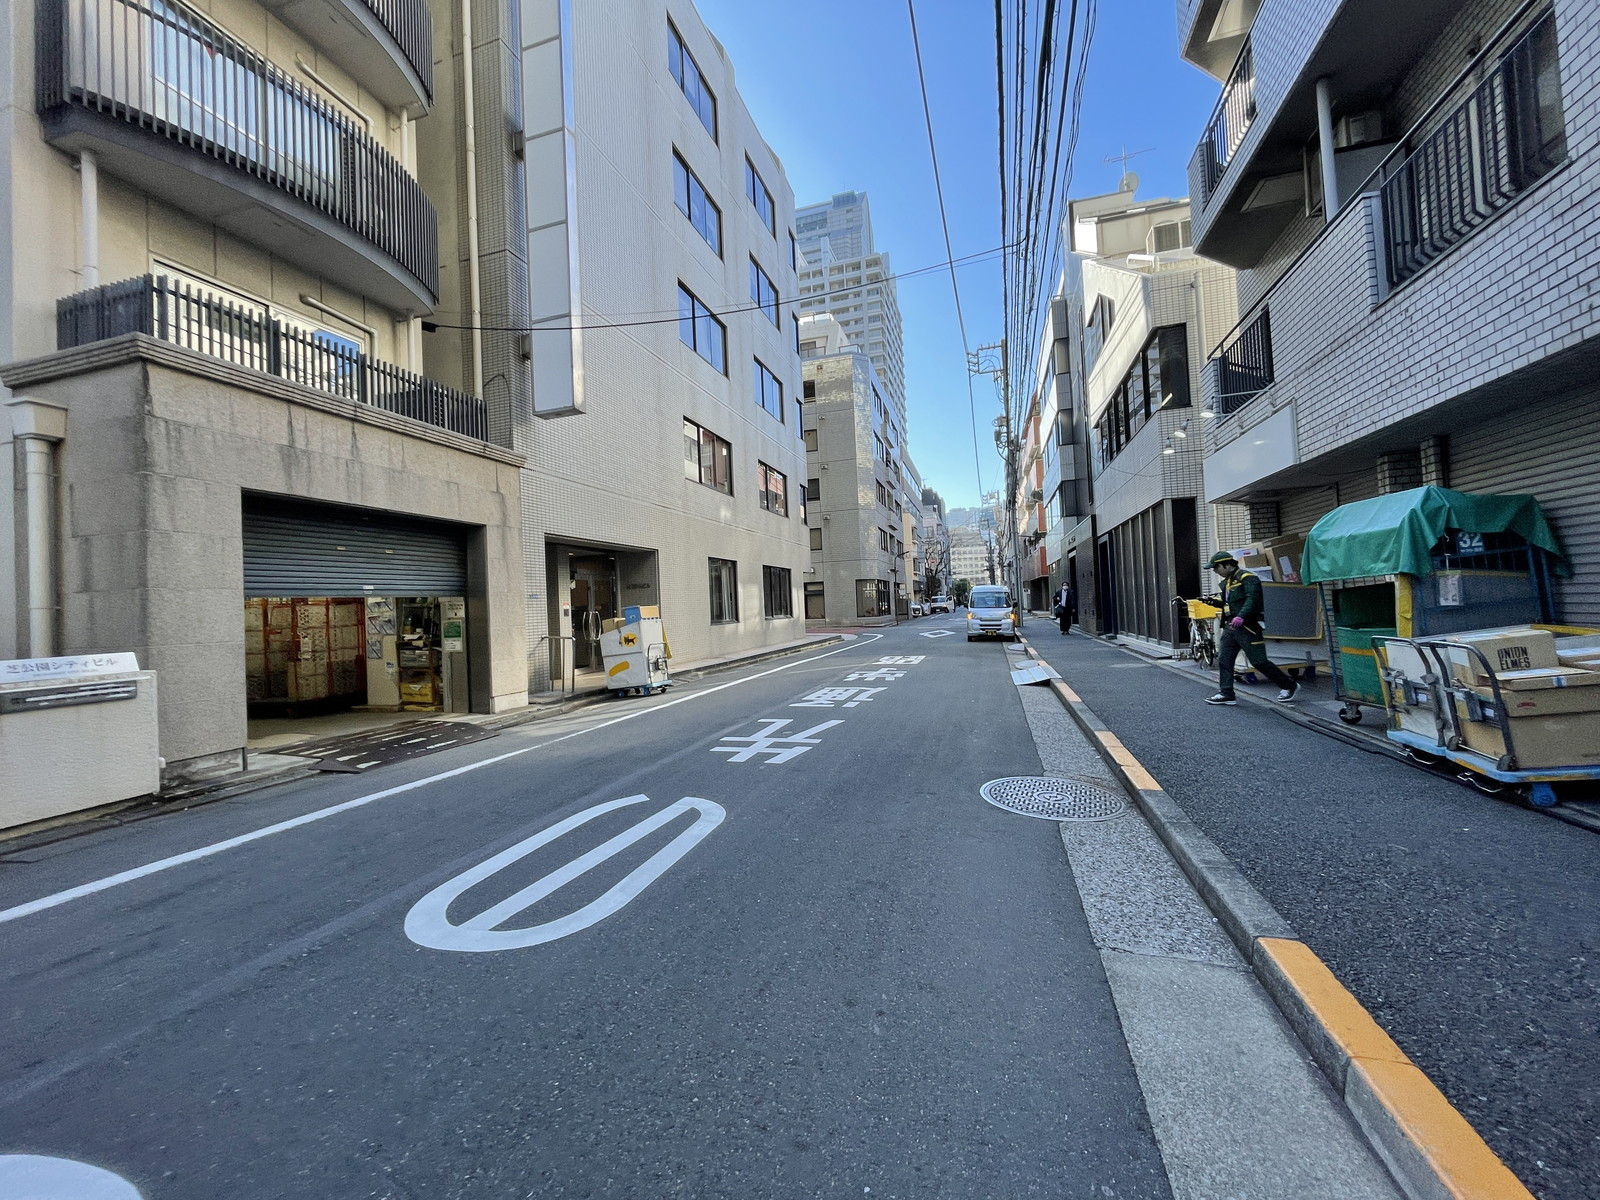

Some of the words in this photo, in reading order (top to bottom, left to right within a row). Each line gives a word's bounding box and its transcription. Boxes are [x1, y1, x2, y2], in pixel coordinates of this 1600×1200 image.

[1458, 532, 1483, 548] 32
[1497, 647, 1528, 659] UNION
[6, 658, 118, 674] 芝公園シティビル
[1500, 657, 1531, 671] ELMES
